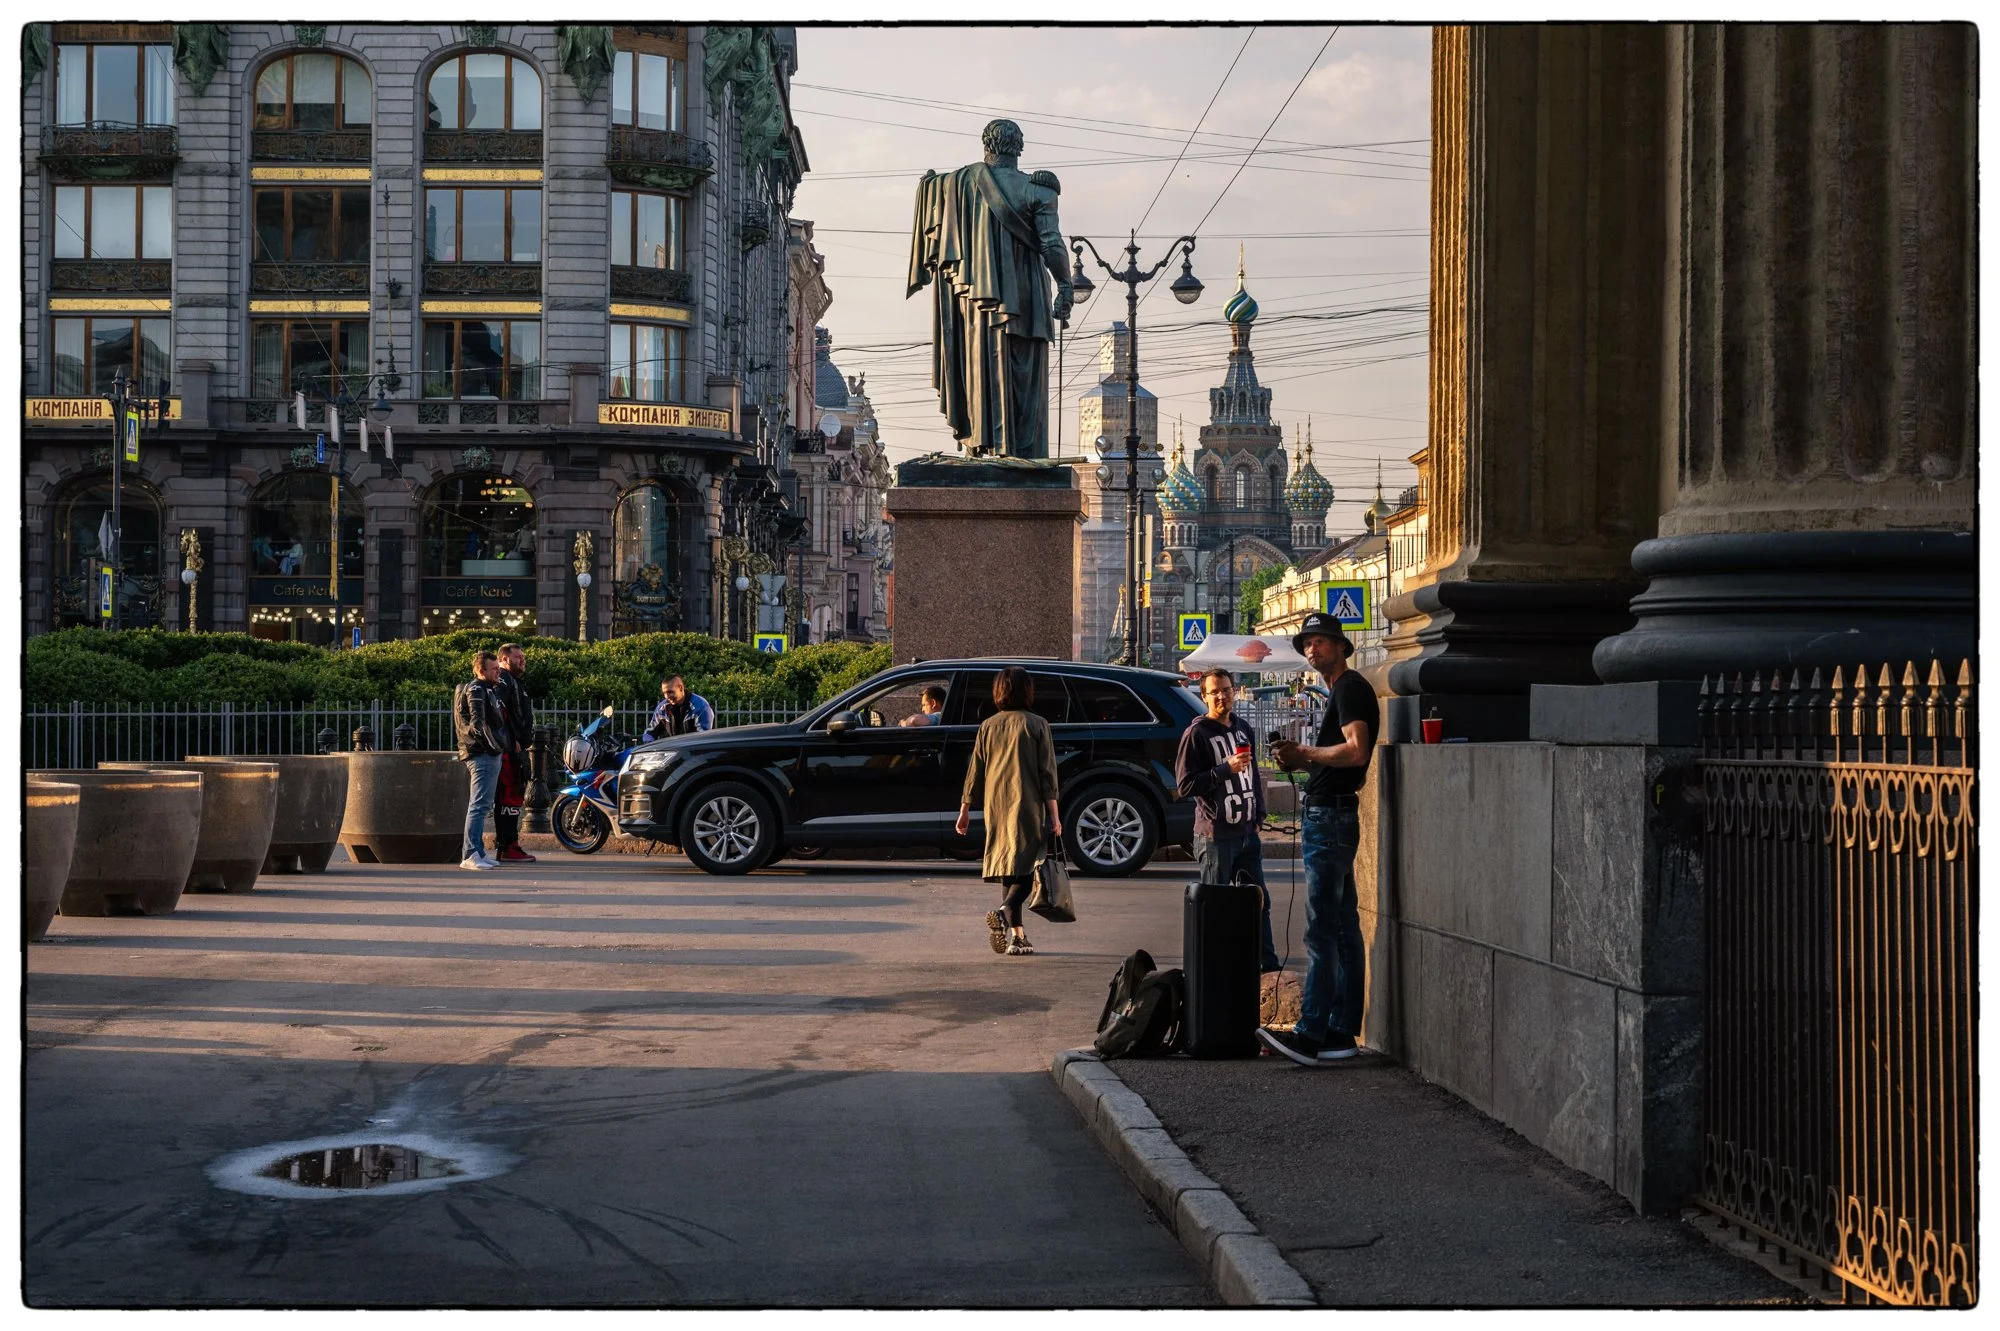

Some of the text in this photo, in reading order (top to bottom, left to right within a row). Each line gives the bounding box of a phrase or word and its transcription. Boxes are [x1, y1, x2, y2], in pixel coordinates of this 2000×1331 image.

[32, 399, 102, 417] КОМПАНІЯ
[608, 406, 727, 430] КОМПАНІЯ ЗИНГЕРЪ
[273, 583, 305, 596] Cafe
[445, 583, 513, 598] Cafe René
